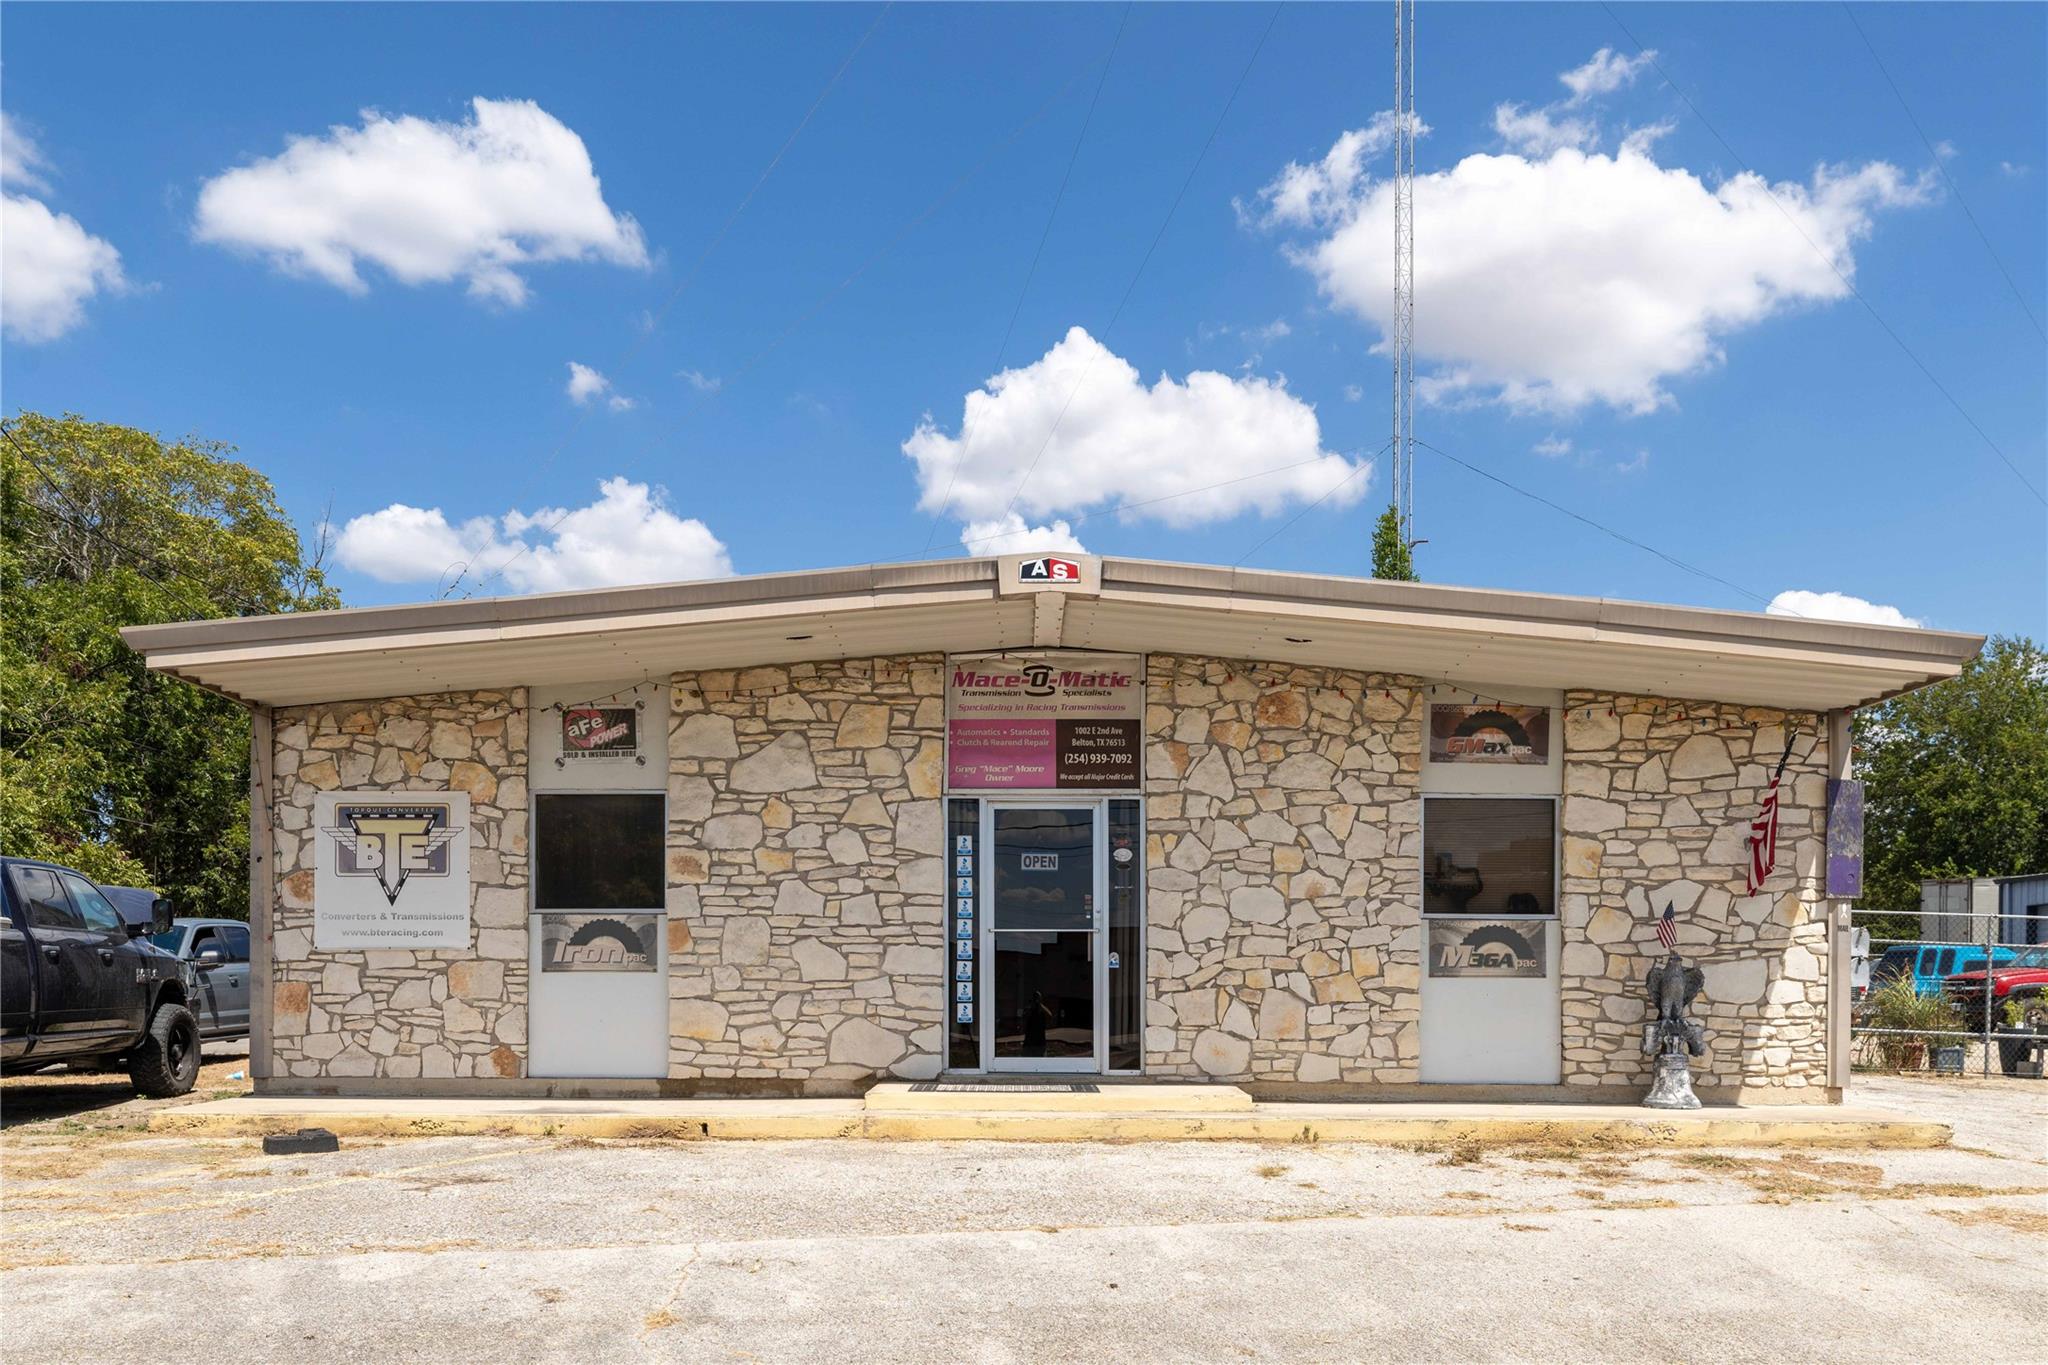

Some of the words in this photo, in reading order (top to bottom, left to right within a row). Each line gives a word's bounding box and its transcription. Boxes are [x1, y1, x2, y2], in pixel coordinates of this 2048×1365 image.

[952, 669, 1131, 689] Mace-O-Matic
[961, 689, 1021, 697] Transmission
[1062, 689, 1112, 698] Specialists
[958, 703, 1012, 712] Specializing
[1015, 703, 1024, 711] in
[1026, 703, 1058, 712] Racing
[1060, 703, 1126, 711] Transmissions
[567, 717, 603, 737] aFe
[1074, 726, 1091, 735] 1002
[1092, 726, 1096, 735] E
[1097, 726, 1110, 735] 2nd
[1110, 726, 1123, 735] Ave
[590, 722, 628, 749] POWER
[956, 728, 1001, 736] Automatics
[1009, 728, 1050, 736] Standards
[957, 738, 982, 746] Clutch
[982, 738, 989, 746] &
[990, 738, 1023, 746] Rearend
[1024, 738, 1049, 747] Repair
[1071, 738, 1096, 747] Belton,
[1096, 738, 1105, 747] TX
[1106, 738, 1126, 747] 76513
[621, 750, 637, 758] HERE
[1510, 744, 1533, 757] pac
[1064, 753, 1089, 765] (254)
[1090, 753, 1133, 764] 939-7092
[954, 765, 977, 774] Greg
[1014, 765, 1045, 773] Moore
[985, 774, 1014, 782] Owner
[355, 819, 430, 896] BTE
[1023, 855, 1057, 868] OPEN
[321, 912, 377, 921] Converters
[380, 912, 387, 921] &
[391, 912, 465, 921] Transmissions
[341, 929, 444, 939] www.bteracing.com
[552, 941, 625, 963] Iron
[624, 953, 648, 966] pac
[1515, 958, 1538, 971] pac
